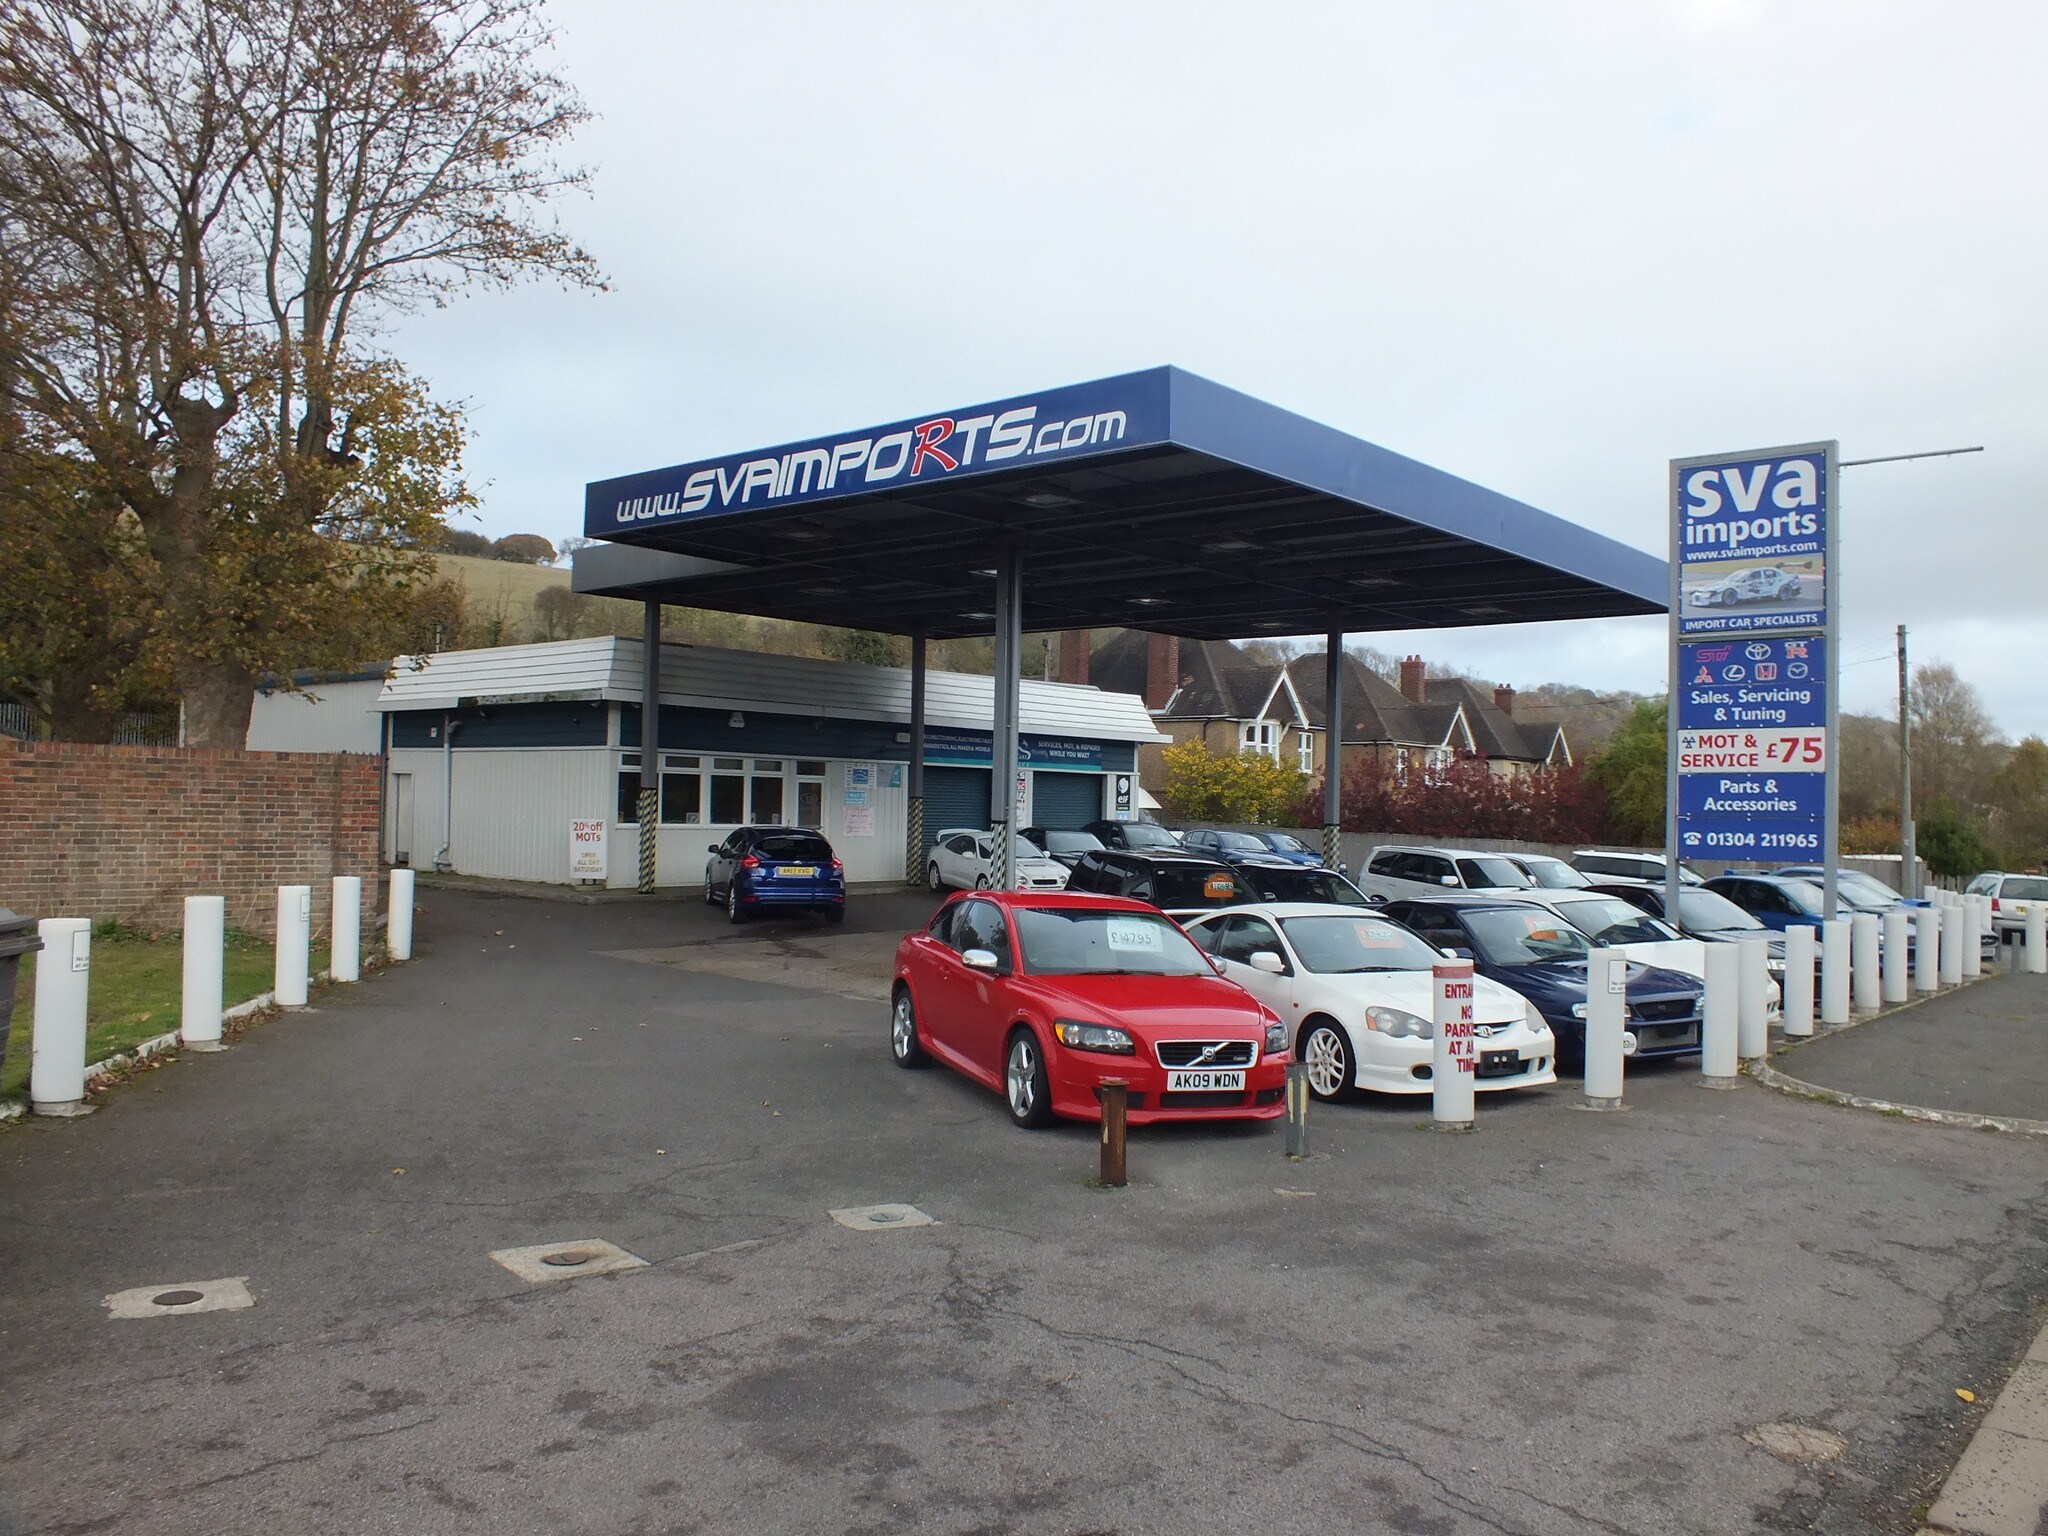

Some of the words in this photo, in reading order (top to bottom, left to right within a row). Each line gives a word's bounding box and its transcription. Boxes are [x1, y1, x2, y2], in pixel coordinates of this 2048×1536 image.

[1686, 459, 1817, 517] sva
[1686, 511, 1817, 548] imports
[1686, 542, 1817, 561] www.svaimports.com
[1685, 619, 1727, 630] IMPORT
[1729, 617, 1751, 628] CAR
[1753, 613, 1818, 626] SPECIALISTS
[1691, 690, 1734, 705] Sales,
[1738, 688, 1811, 704] Servicing
[1714, 708, 1728, 721] &
[1731, 706, 1786, 722] Tuning
[1699, 734, 1739, 749] MOT
[1744, 734, 1758, 748] &
[1766, 736, 1823, 764] £75
[1680, 753, 1759, 768] SERVICE
[1719, 779, 1760, 794] Parts
[1764, 779, 1779, 793] &
[1703, 796, 1797, 812] Accessories
[590, 821, 604, 831] off
[575, 832, 602, 842] MOTs
[1706, 832, 1755, 847] 01304
[1760, 832, 1819, 848] 211965
[1461, 1005, 1473, 1020] NO
[1448, 1040, 1462, 1056] AT
[1174, 1073, 1211, 1088] AK09
[1214, 1073, 1240, 1088] WDN
